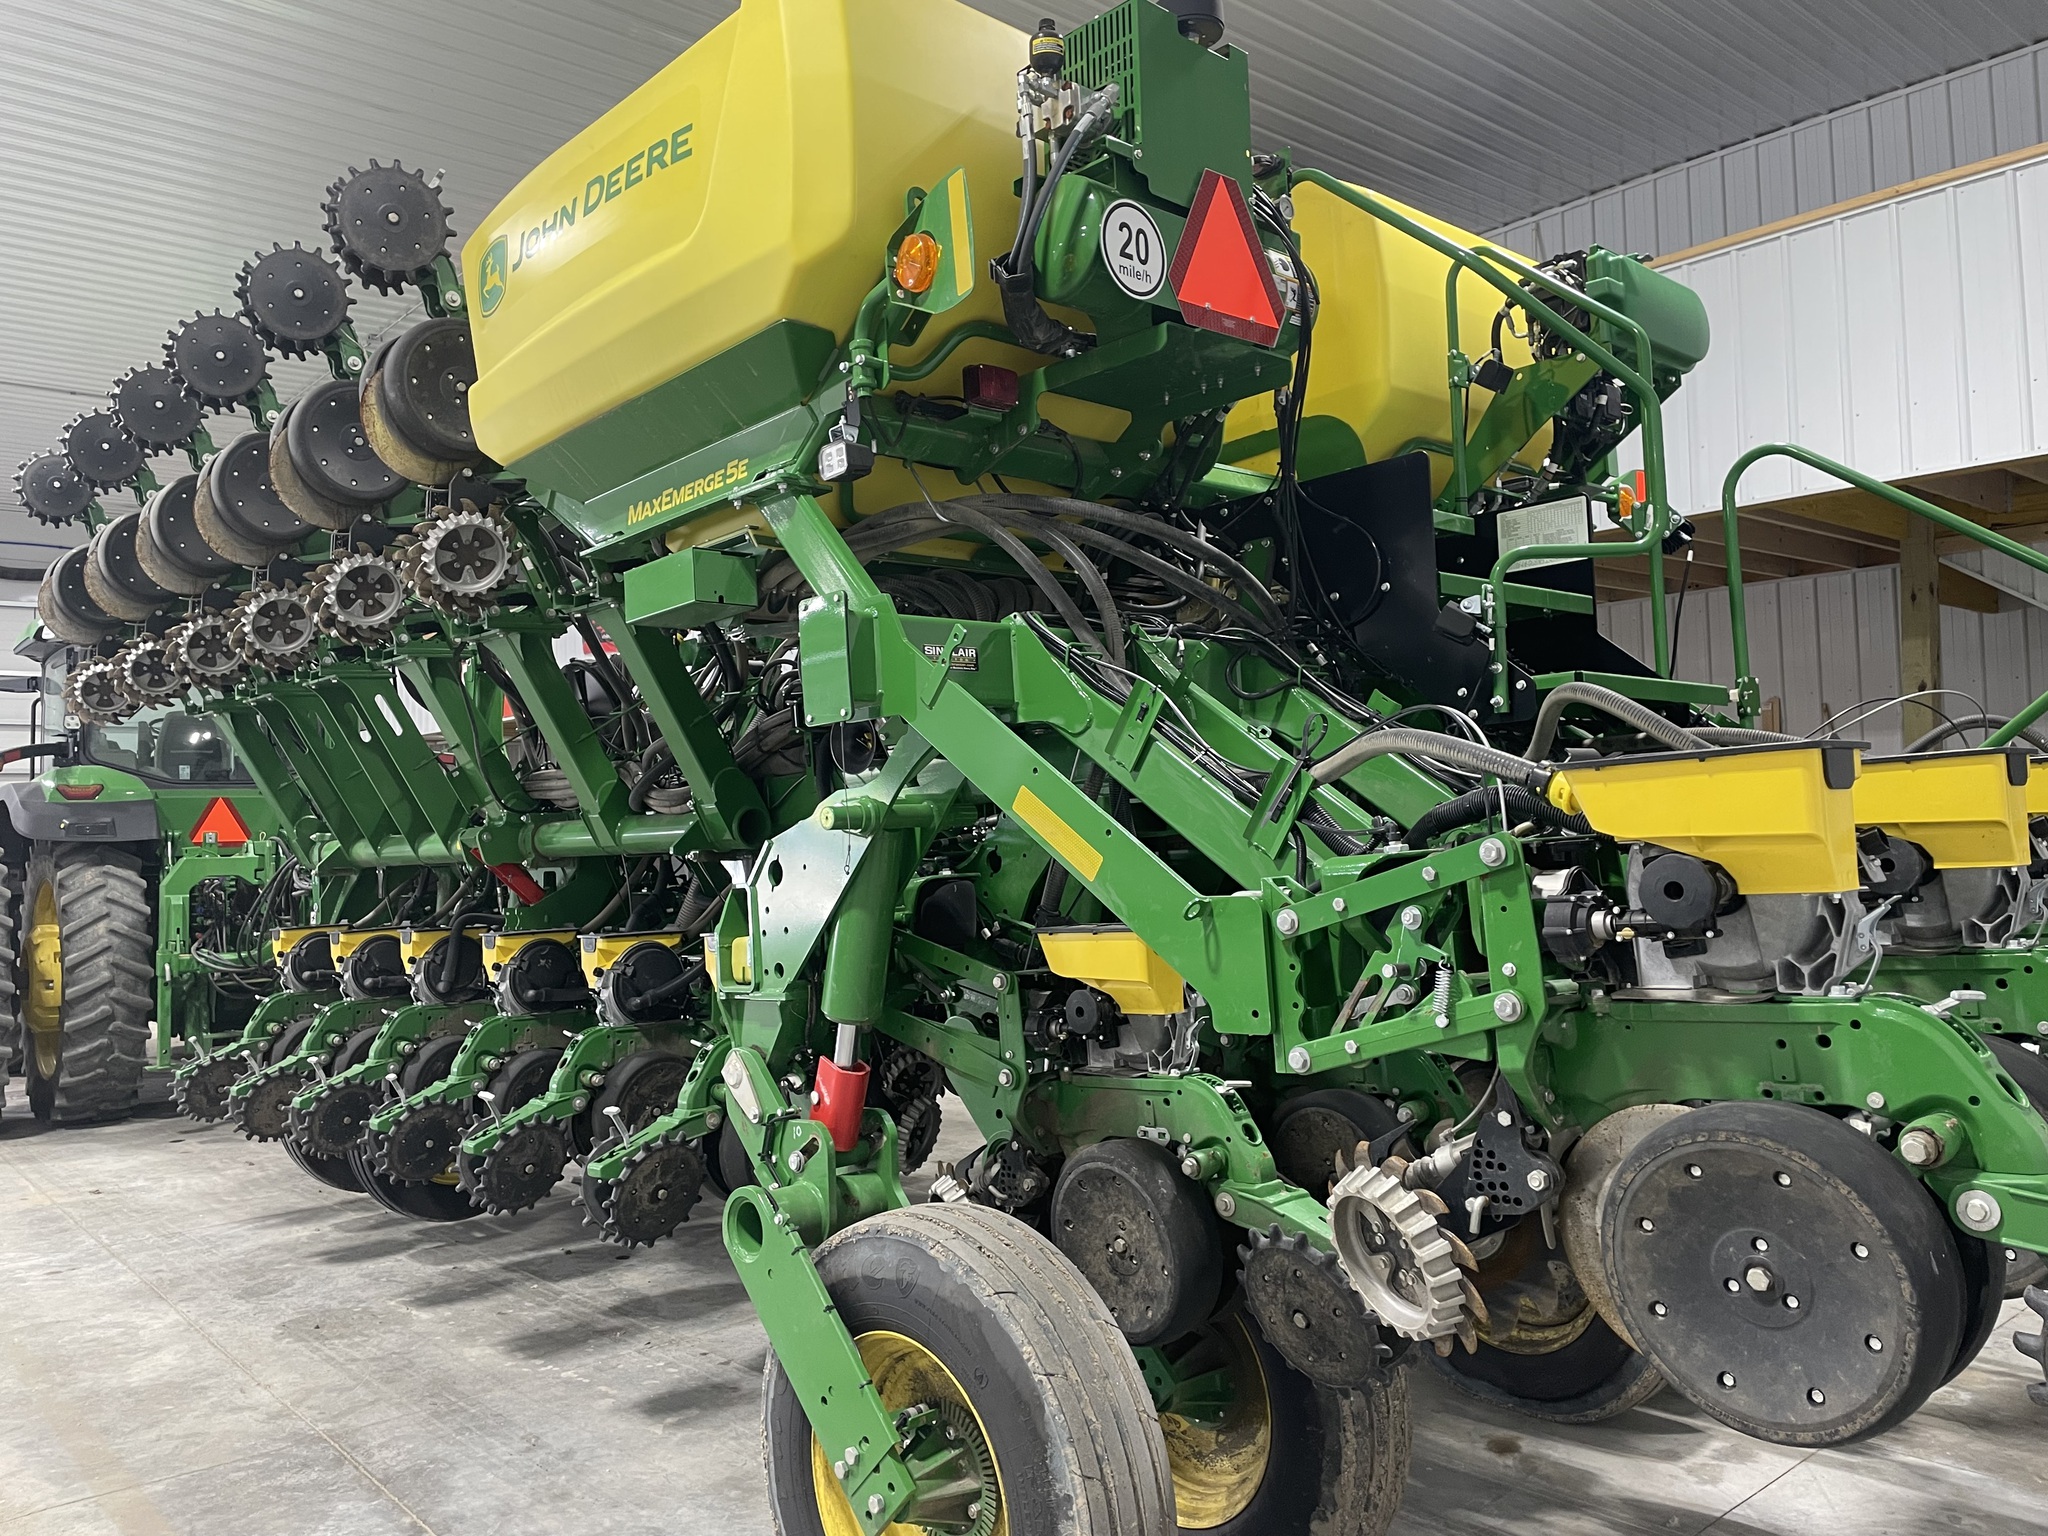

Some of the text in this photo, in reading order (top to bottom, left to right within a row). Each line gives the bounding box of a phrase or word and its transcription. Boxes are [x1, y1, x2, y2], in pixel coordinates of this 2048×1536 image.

[512, 123, 693, 273] JOHN DEERE
[1118, 221, 1150, 266] 20
[1119, 264, 1152, 284] mile/h
[924, 646, 976, 658] SINLAIR
